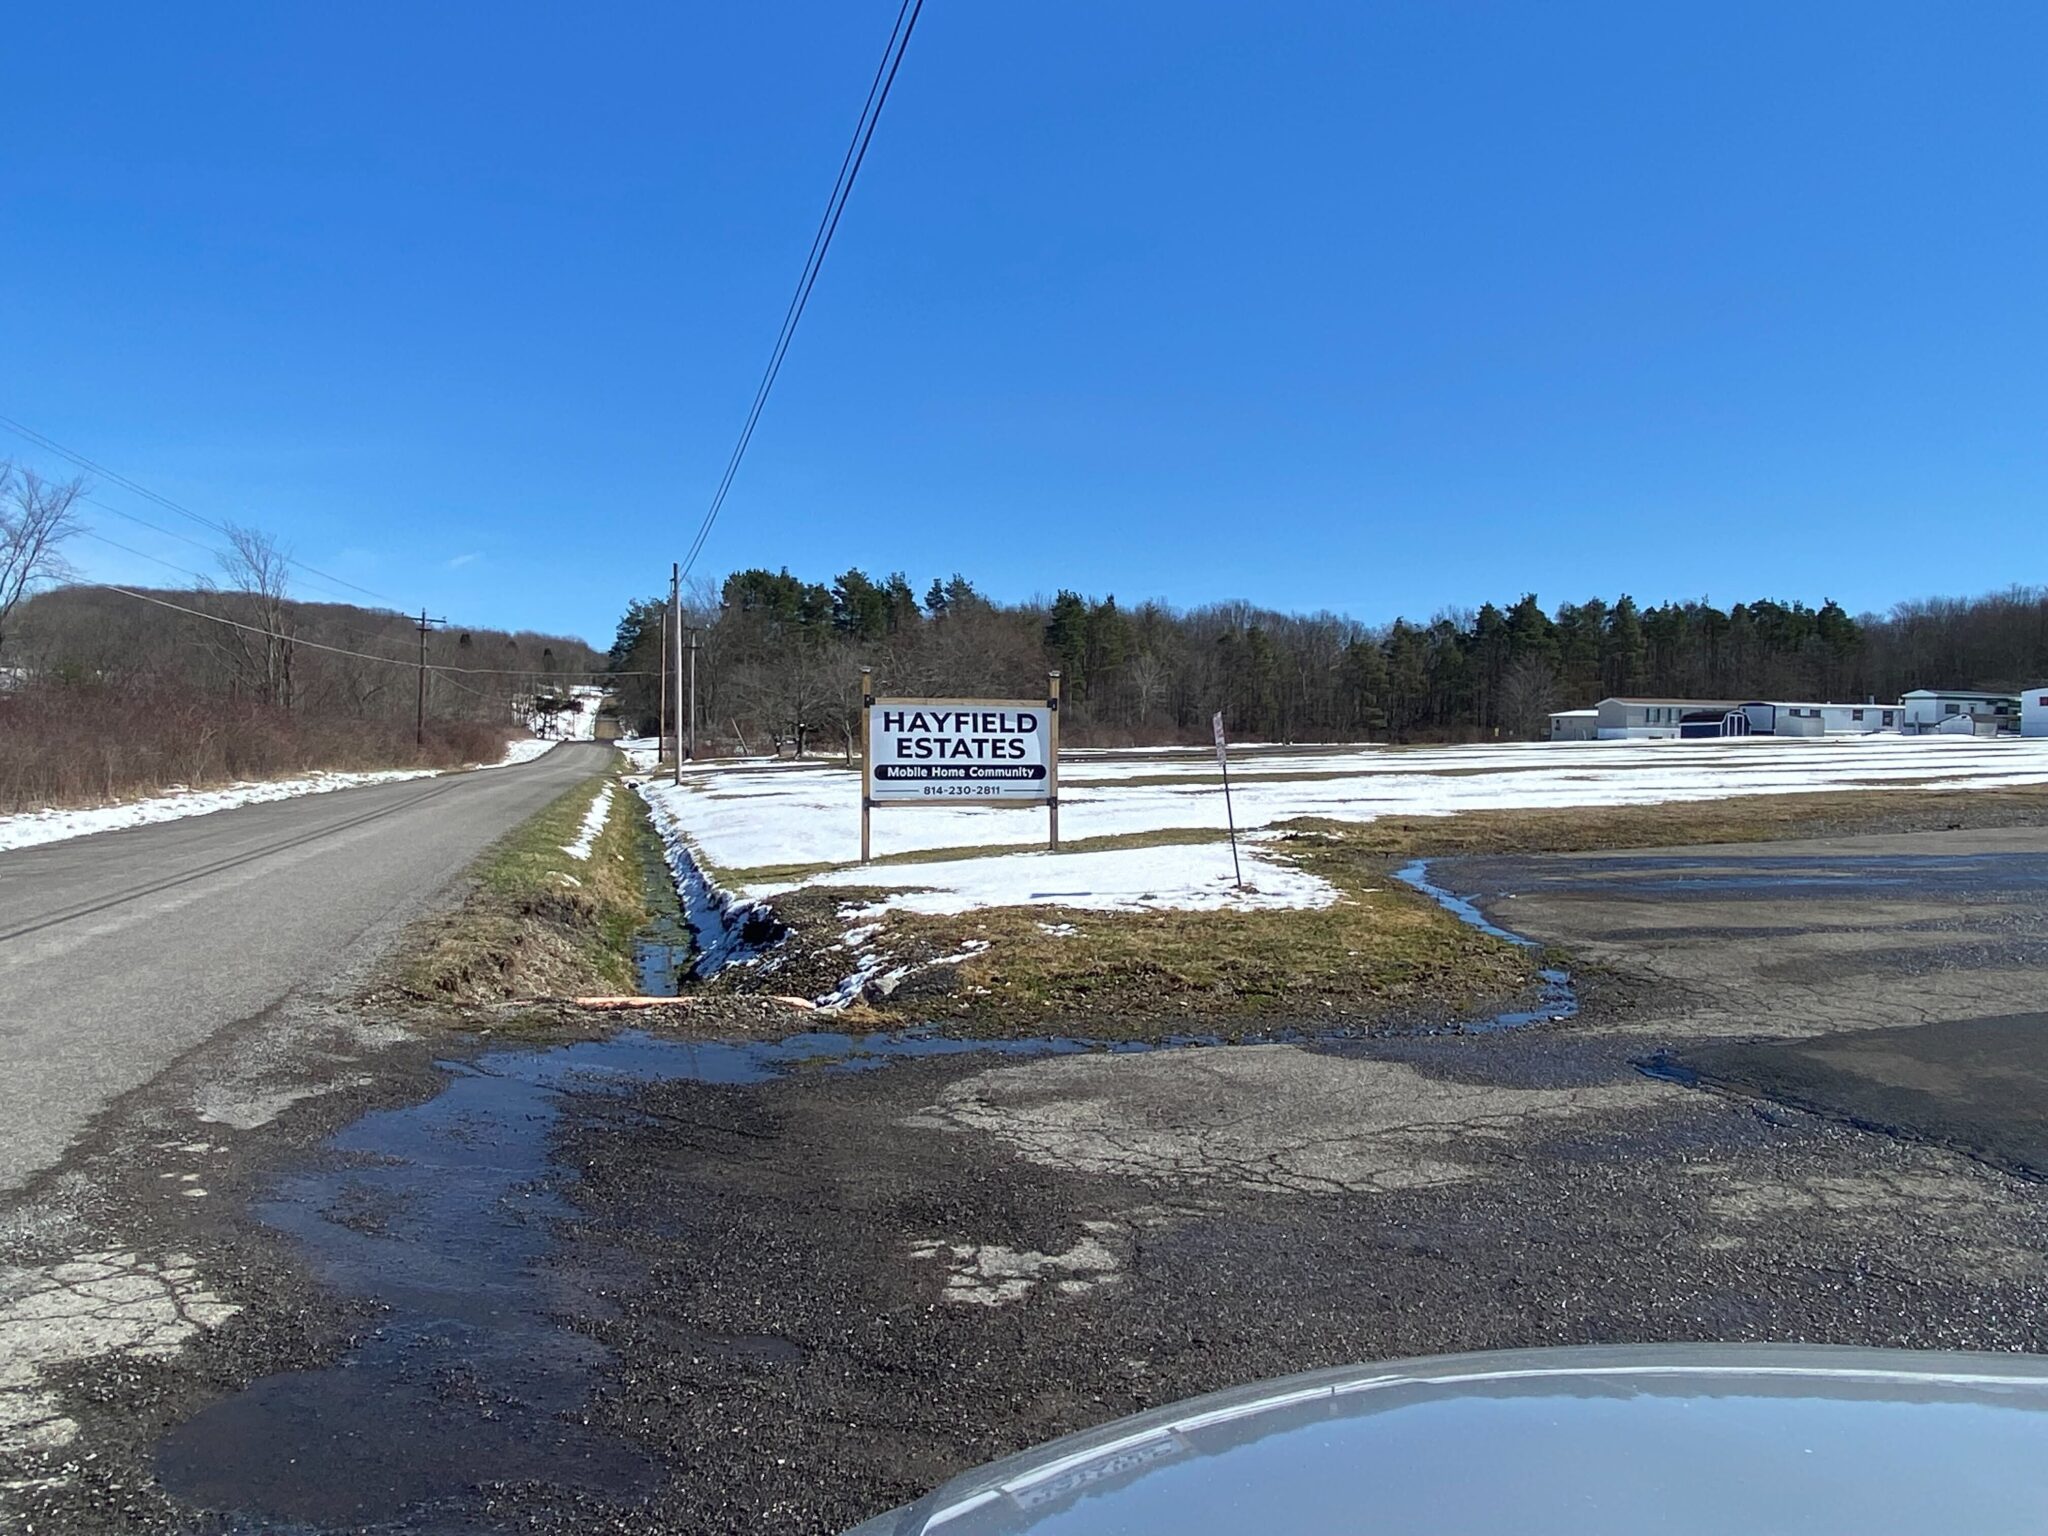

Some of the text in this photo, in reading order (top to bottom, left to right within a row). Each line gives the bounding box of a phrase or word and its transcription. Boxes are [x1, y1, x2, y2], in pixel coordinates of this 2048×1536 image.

[884, 712, 1038, 733] HAYFIELD
[896, 737, 1026, 759] ESTATES
[887, 766, 1035, 779] Mobile Home Community
[923, 785, 1001, 795] 814-230-2811
